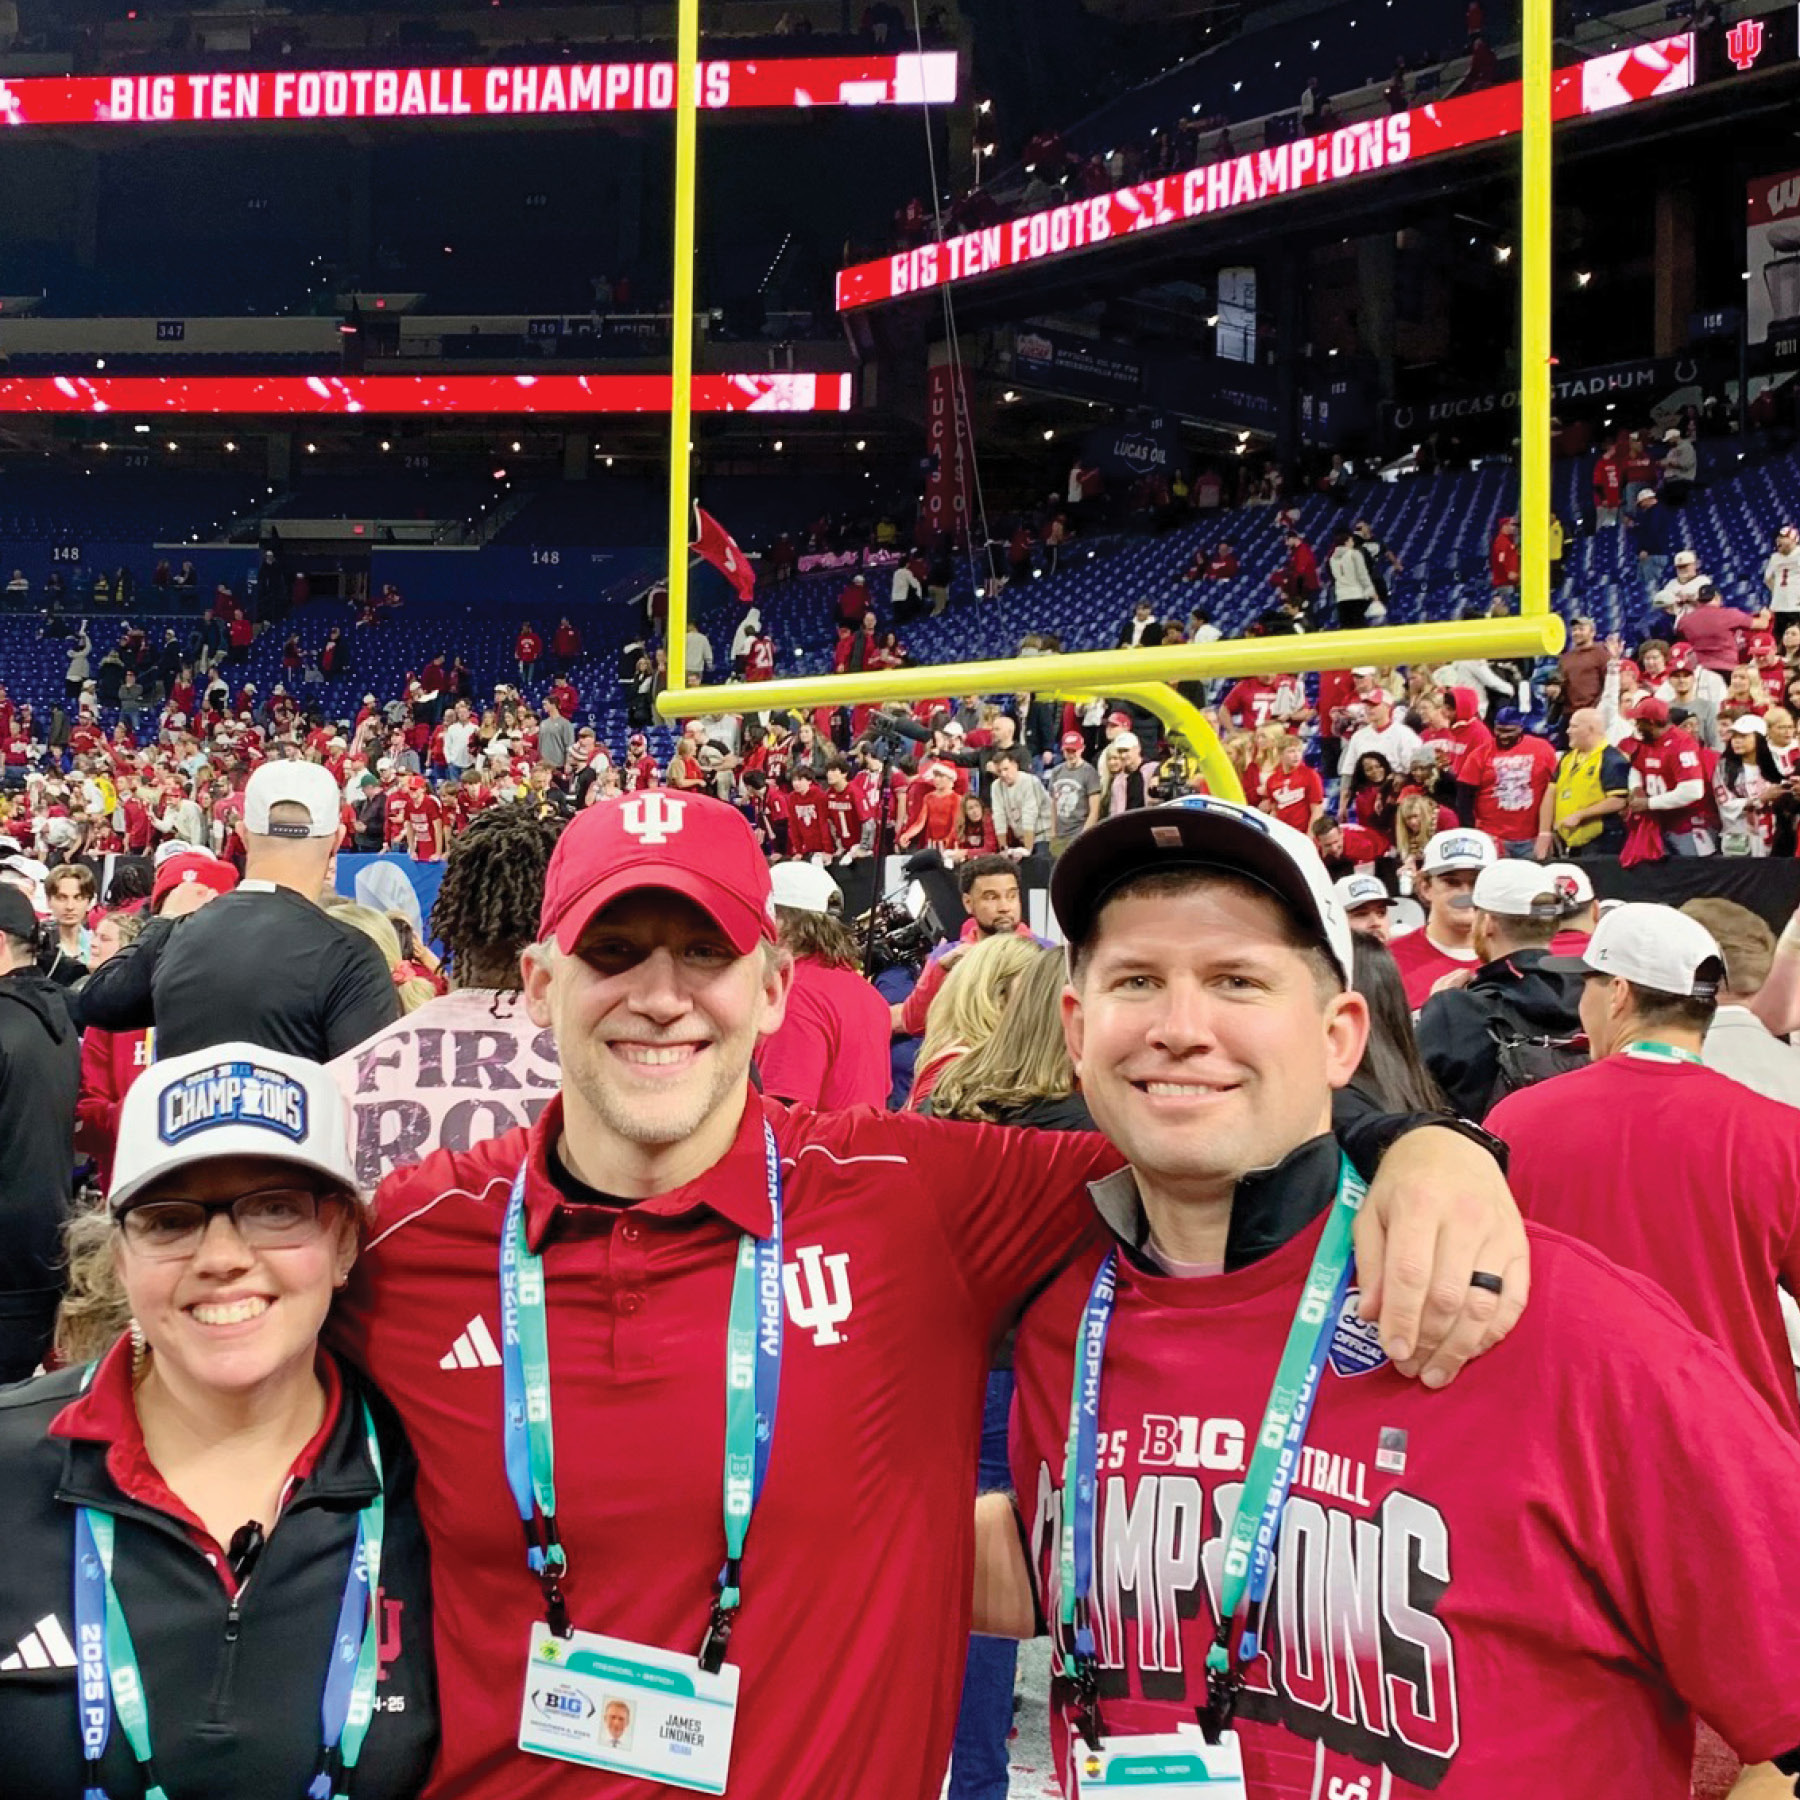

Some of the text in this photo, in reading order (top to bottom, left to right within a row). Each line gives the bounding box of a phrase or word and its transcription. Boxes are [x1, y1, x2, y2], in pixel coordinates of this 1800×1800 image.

[110, 60, 730, 120] BIG TEN FOOTBALL CHAMPIOS
[890, 244, 937, 296] BIG
[947, 229, 1000, 281] TEN
[1183, 111, 1412, 218] CHAMPIONS
[158, 325, 182, 338] 347
[1429, 394, 1494, 421] LUCAS
[53, 547, 80, 561] 148
[531, 551, 560, 566] 148
[758, 1241, 781, 1358] TROPHY
[1082, 1305, 1111, 1417] TROPHY
[80, 1623, 103, 1702] 2025
[665, 1714, 702, 1732] JAMES
[659, 1726, 705, 1748] LINDNER
